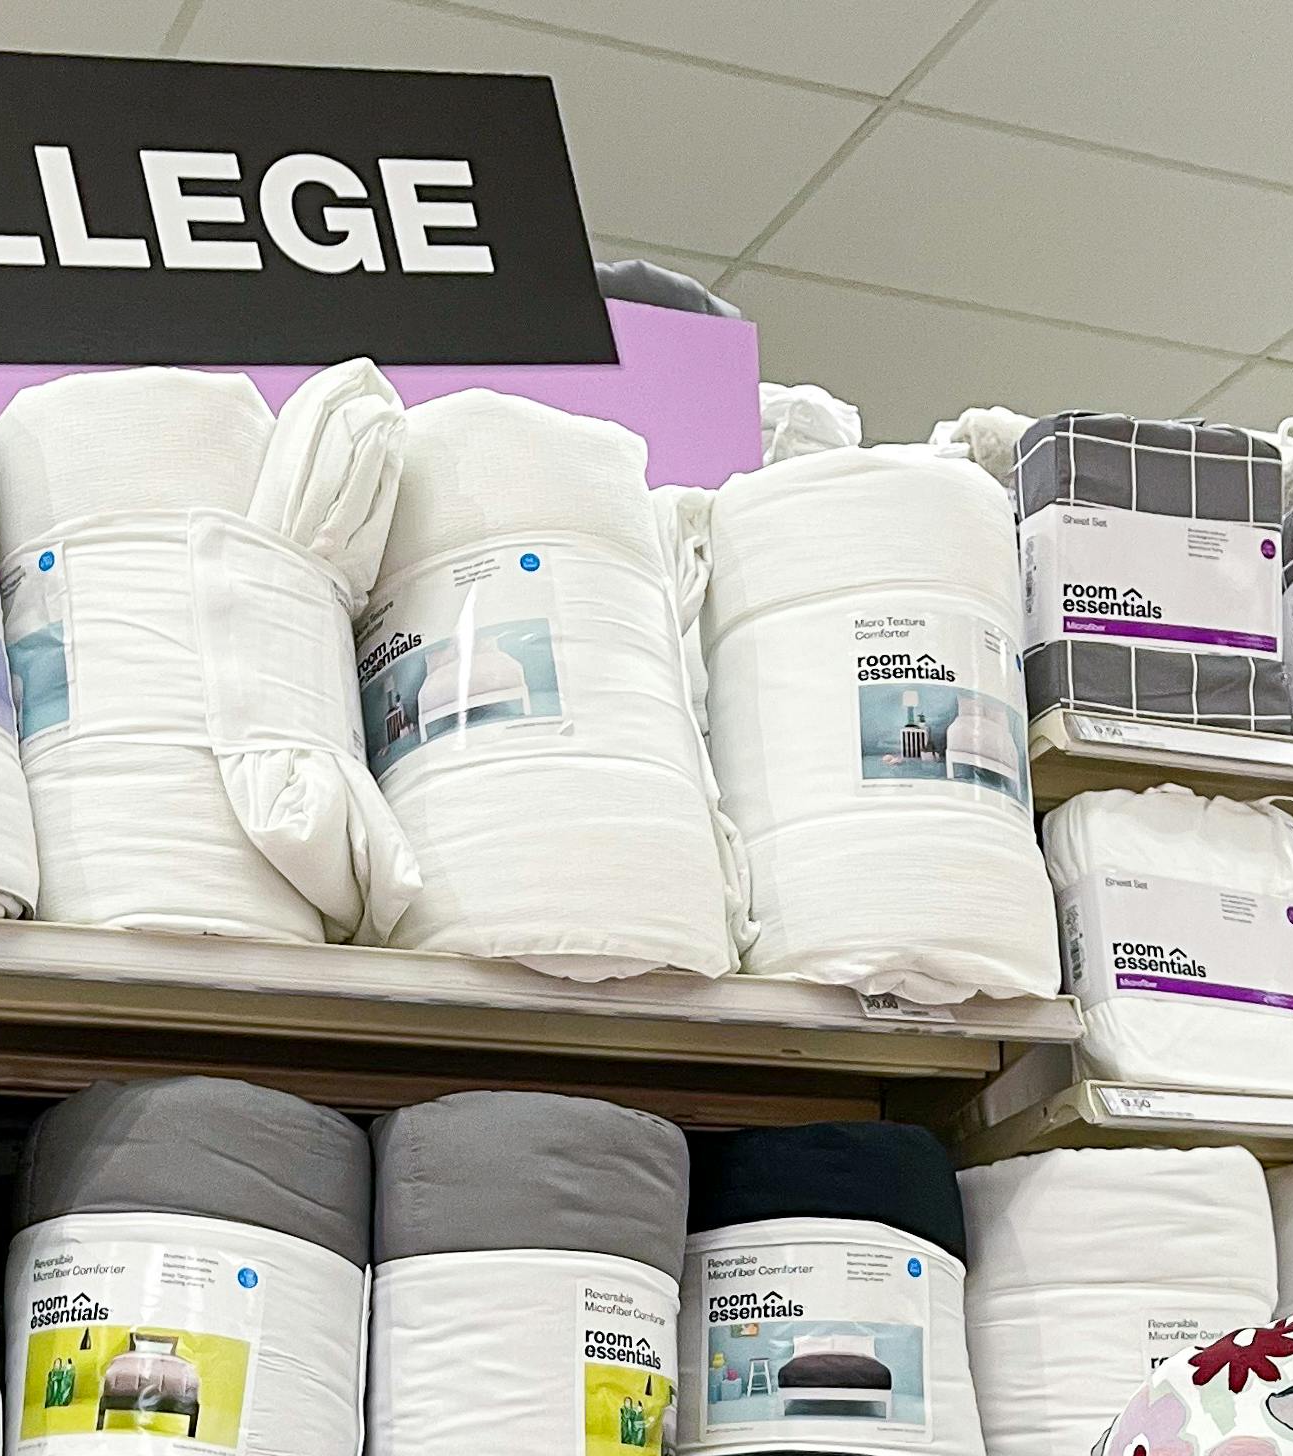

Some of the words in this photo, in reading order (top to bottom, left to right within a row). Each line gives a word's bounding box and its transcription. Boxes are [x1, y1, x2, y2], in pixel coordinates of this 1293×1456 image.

[1063, 583, 1117, 601] room
[1062, 598, 1163, 619] essentials
[857, 653, 911, 668] room
[857, 664, 956, 682] essentials
[1112, 941, 1164, 958] room
[1113, 955, 1207, 978] essentials
[72, 1264, 126, 1277] Comforter
[707, 1255, 758, 1269] Reversible
[708, 1267, 756, 1281] Microfiber
[758, 1264, 814, 1276] Comforter
[31, 1295, 69, 1315] room
[584, 1288, 634, 1304] Reversible
[708, 1292, 758, 1310] room
[30, 1302, 110, 1330] essentials
[584, 1301, 633, 1317] Microfiber
[708, 1300, 805, 1323] essentials
[584, 1329, 633, 1349] room
[584, 1344, 662, 1370] essentials
